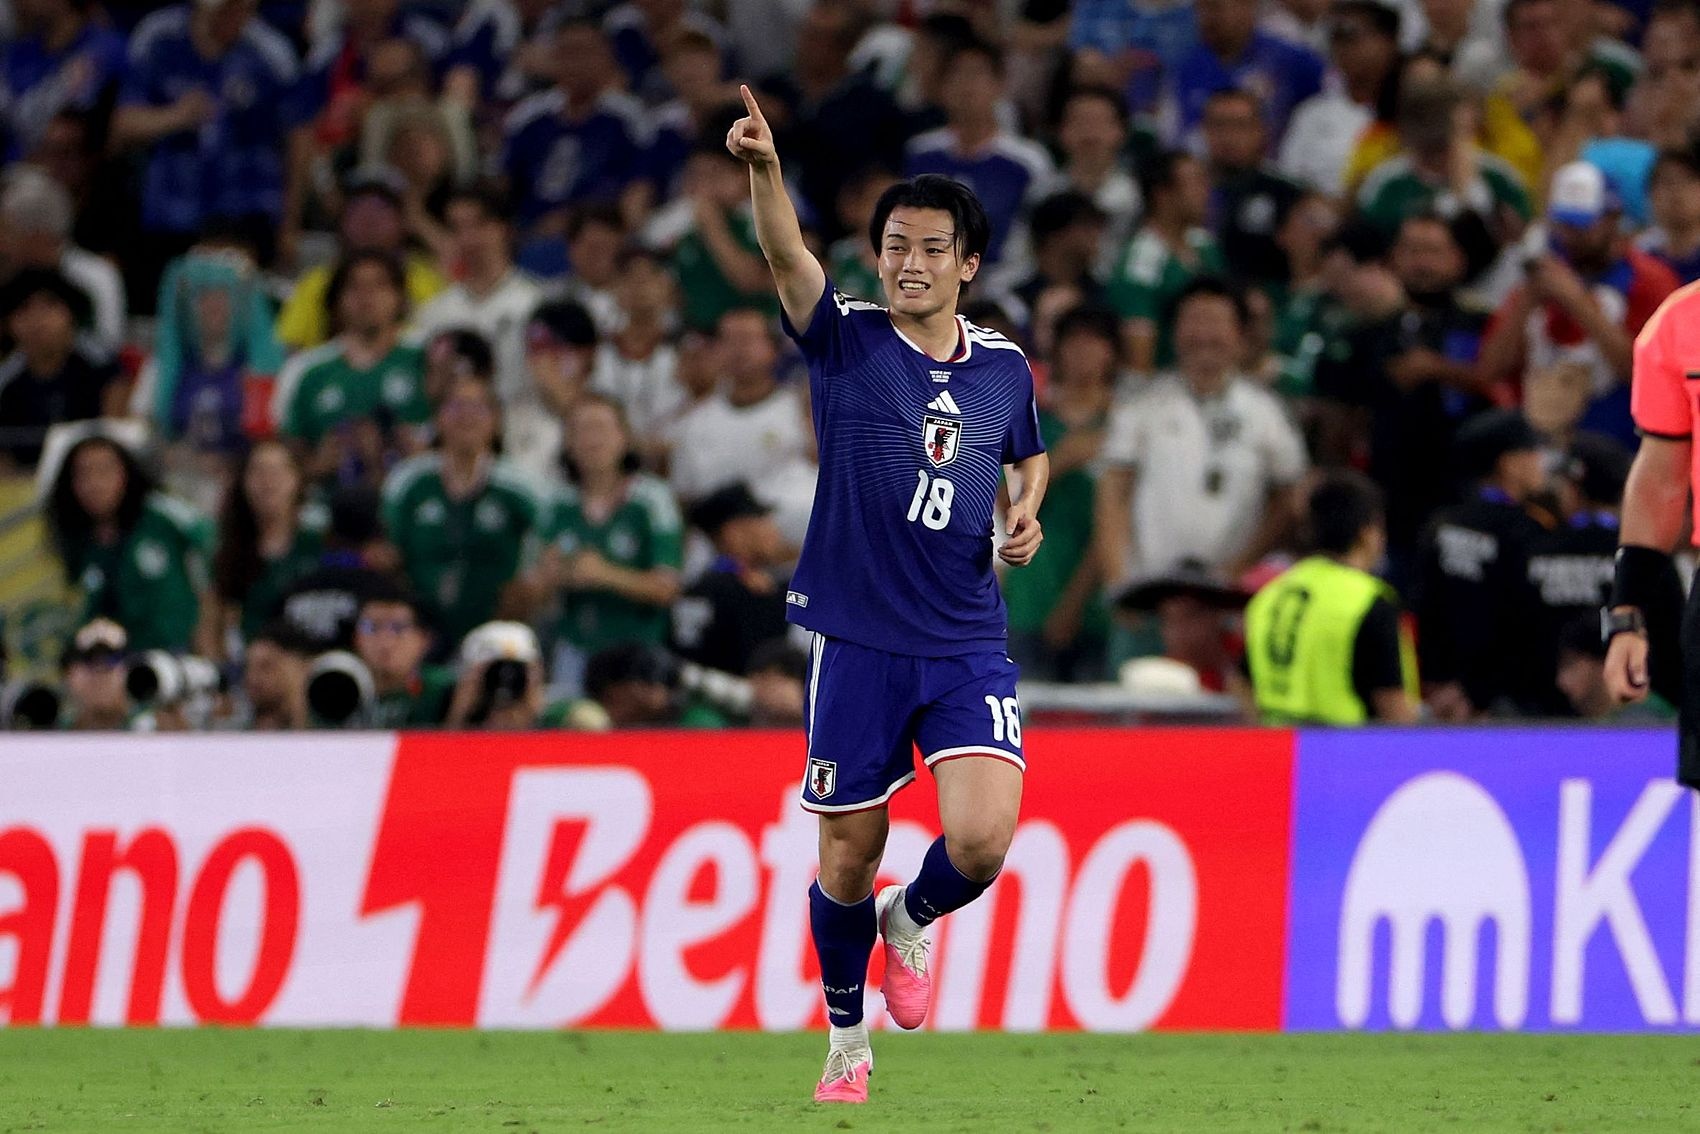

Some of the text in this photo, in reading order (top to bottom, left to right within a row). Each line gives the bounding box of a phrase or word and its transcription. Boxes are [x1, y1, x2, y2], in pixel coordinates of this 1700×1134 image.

[907, 470, 954, 530] 18
[985, 695, 1021, 748] 18
[1552, 779, 1700, 1024] K
